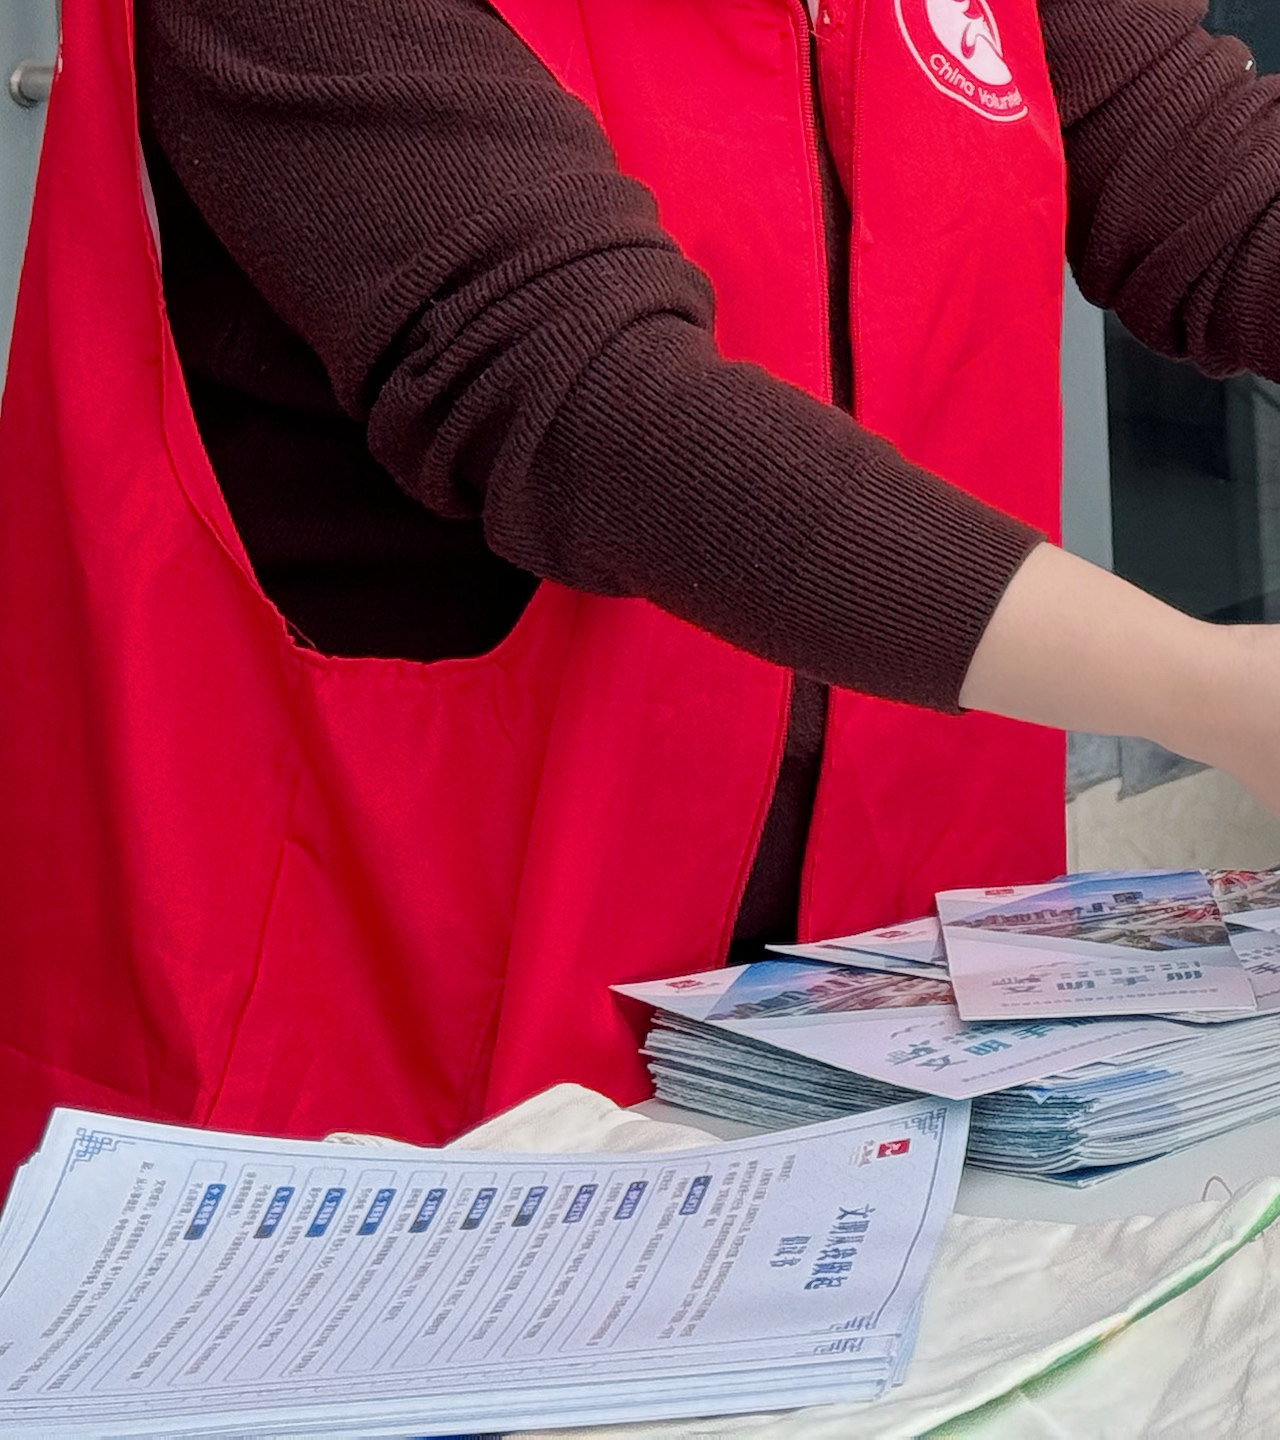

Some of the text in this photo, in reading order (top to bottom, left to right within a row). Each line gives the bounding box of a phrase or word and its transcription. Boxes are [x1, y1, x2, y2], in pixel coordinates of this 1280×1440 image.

[930, 53, 975, 97] China
[769, 1235, 813, 1268] 倡议书
[803, 1203, 876, 1291] 文明从我做起
